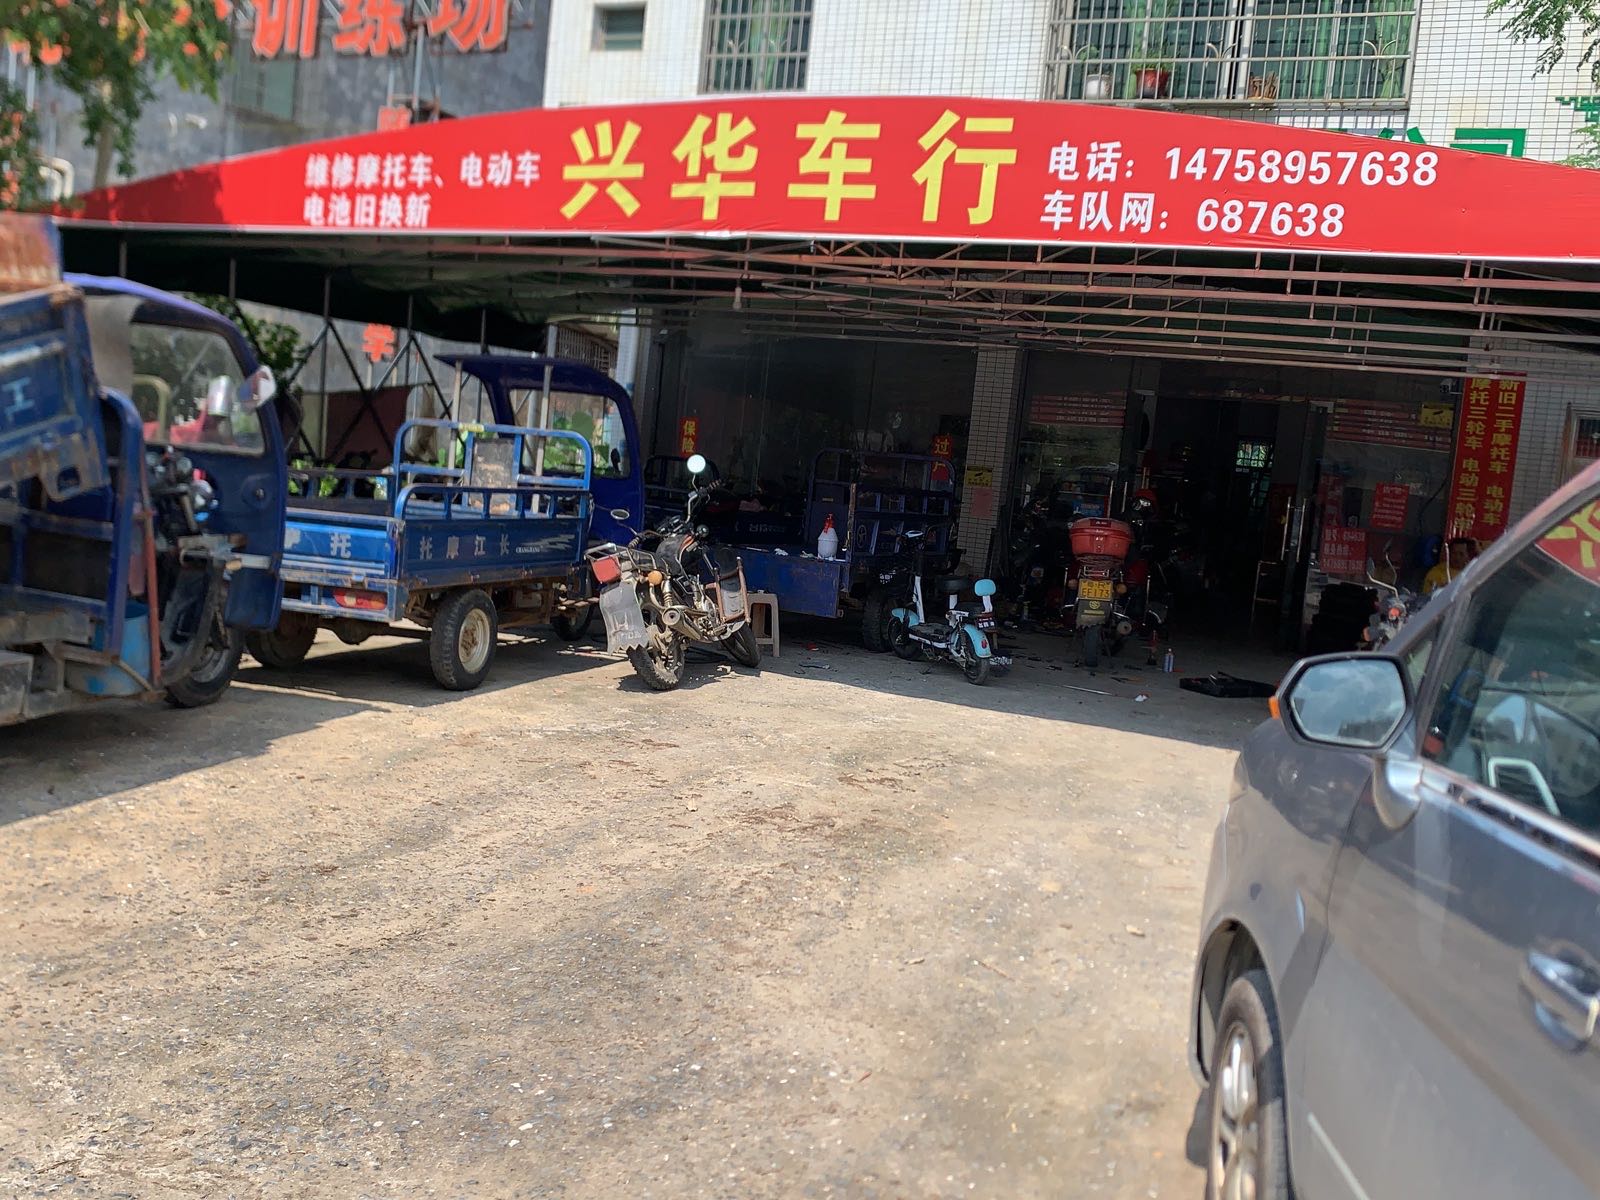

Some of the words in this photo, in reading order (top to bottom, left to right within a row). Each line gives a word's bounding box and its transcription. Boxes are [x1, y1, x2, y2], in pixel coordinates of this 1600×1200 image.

[304, 150, 541, 189] 维修摩托车、电动车
[560, 109, 1018, 226] 兴华车行
[1048, 141, 1134, 182] 电话：
[1165, 146, 1439, 187] 14758957638
[303, 194, 432, 228] 电池旧换新
[1040, 190, 1169, 234] 车队网：
[1196, 198, 1346, 238] 687638
